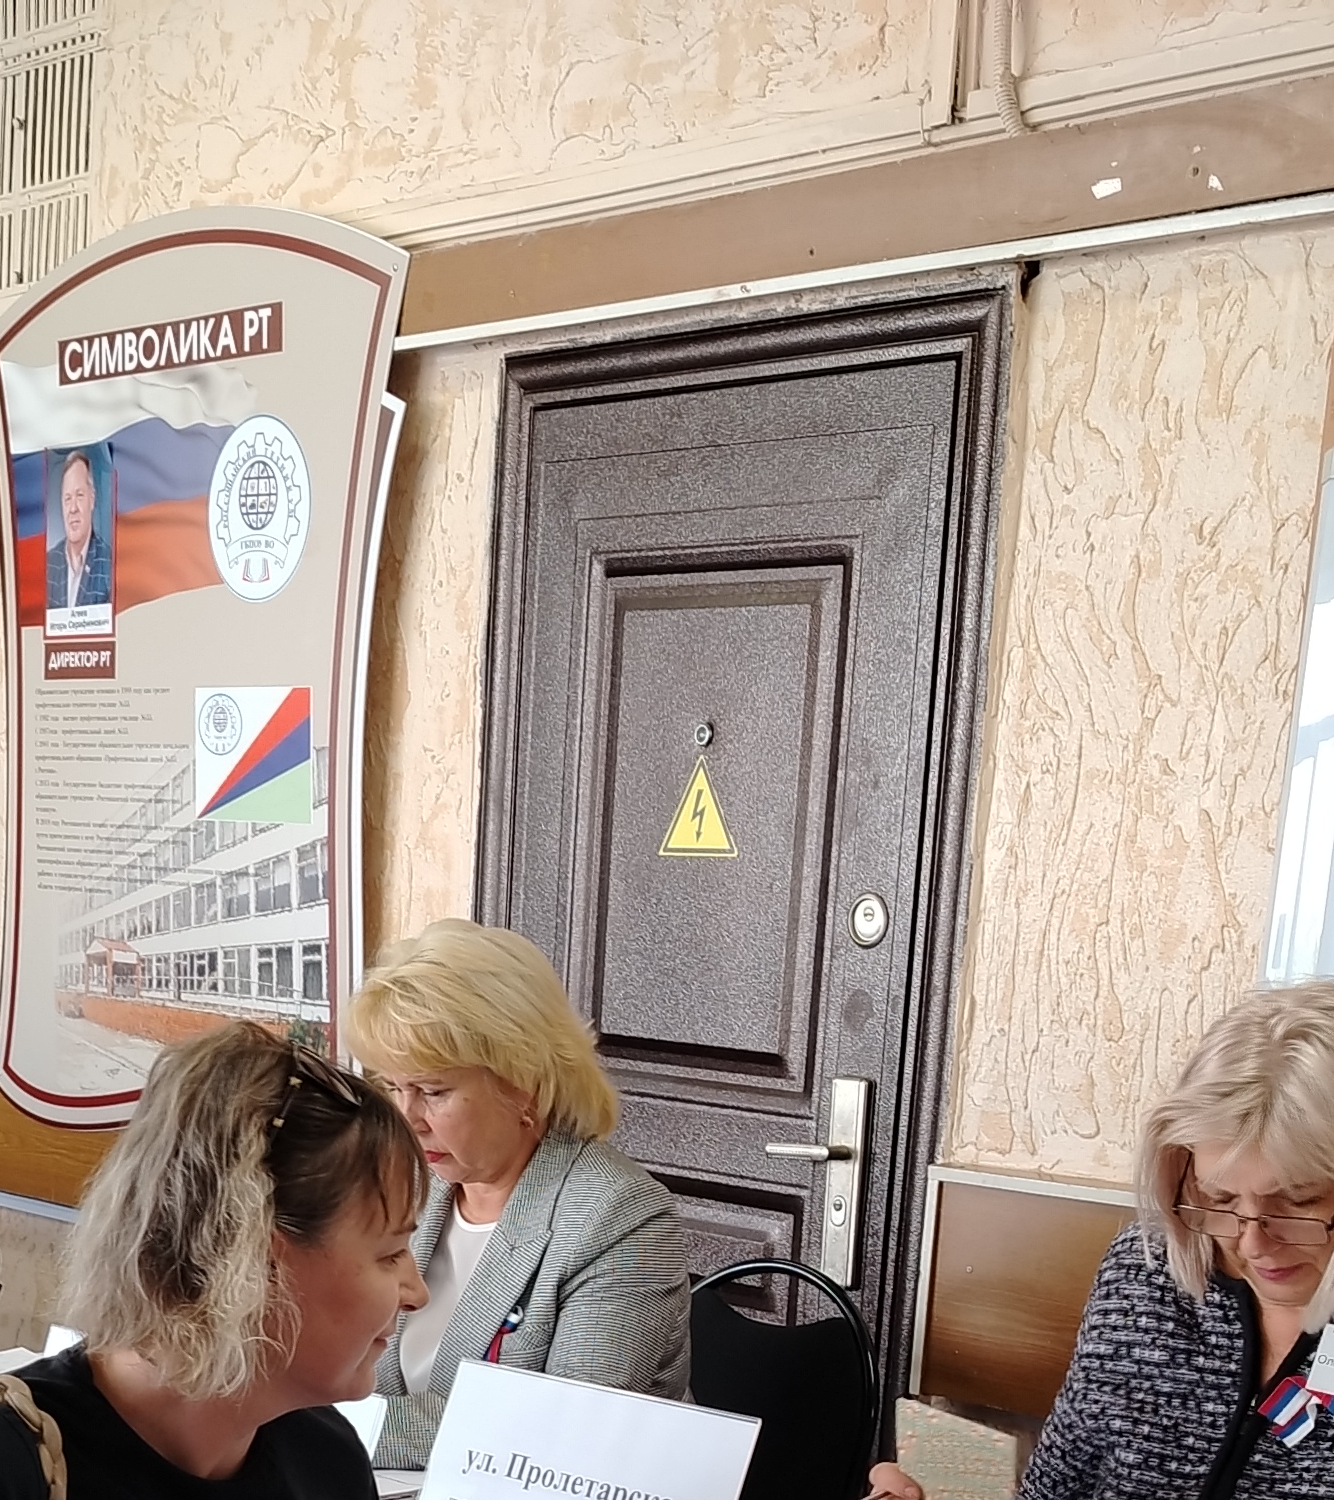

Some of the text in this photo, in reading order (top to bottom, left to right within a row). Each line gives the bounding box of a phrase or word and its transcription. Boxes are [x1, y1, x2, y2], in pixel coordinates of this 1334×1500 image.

[63, 308, 272, 381] СИМВОЛИКА РТ
[264, 539, 275, 549] ВО
[48, 651, 112, 670] ДИРЕКТОР РТ
[461, 1448, 497, 1475] ул.
